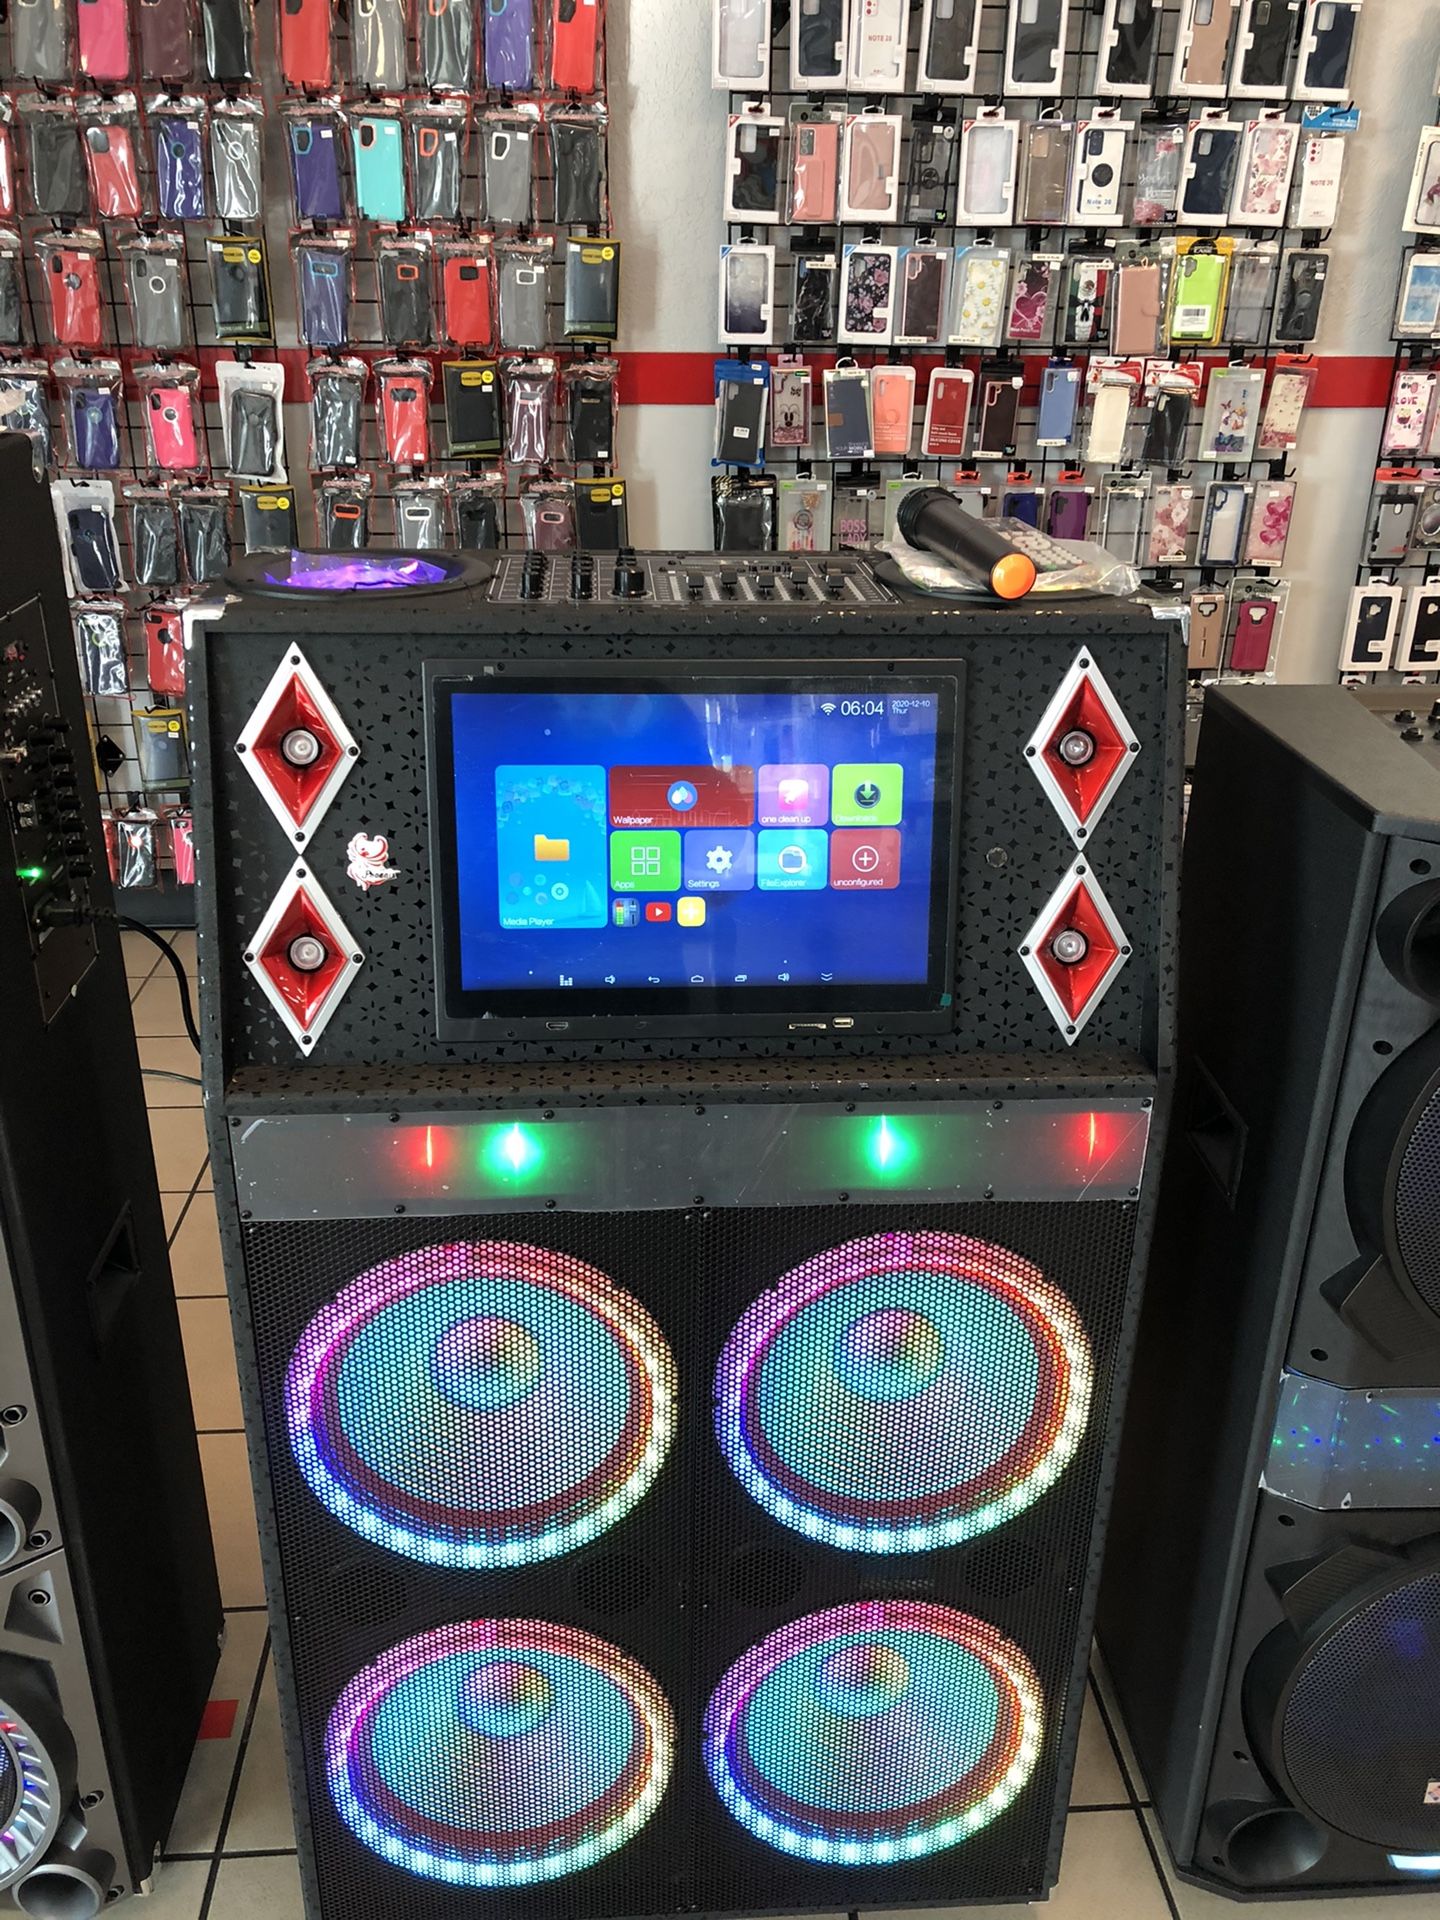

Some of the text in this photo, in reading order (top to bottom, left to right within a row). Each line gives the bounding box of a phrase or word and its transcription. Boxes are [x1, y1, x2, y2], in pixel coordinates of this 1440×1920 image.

[868, 34, 884, 42] NOTE
[840, 519, 867, 533] BOSS
[840, 533, 867, 544] LADY
[840, 700, 931, 716] 06:04 2020-12-10
[612, 815, 654, 825] Wallpaper
[761, 815, 812, 825] one clean up
[687, 879, 720, 889] Settings
[833, 878, 884, 888] unconfigured
[503, 917, 555, 928] Media Player
